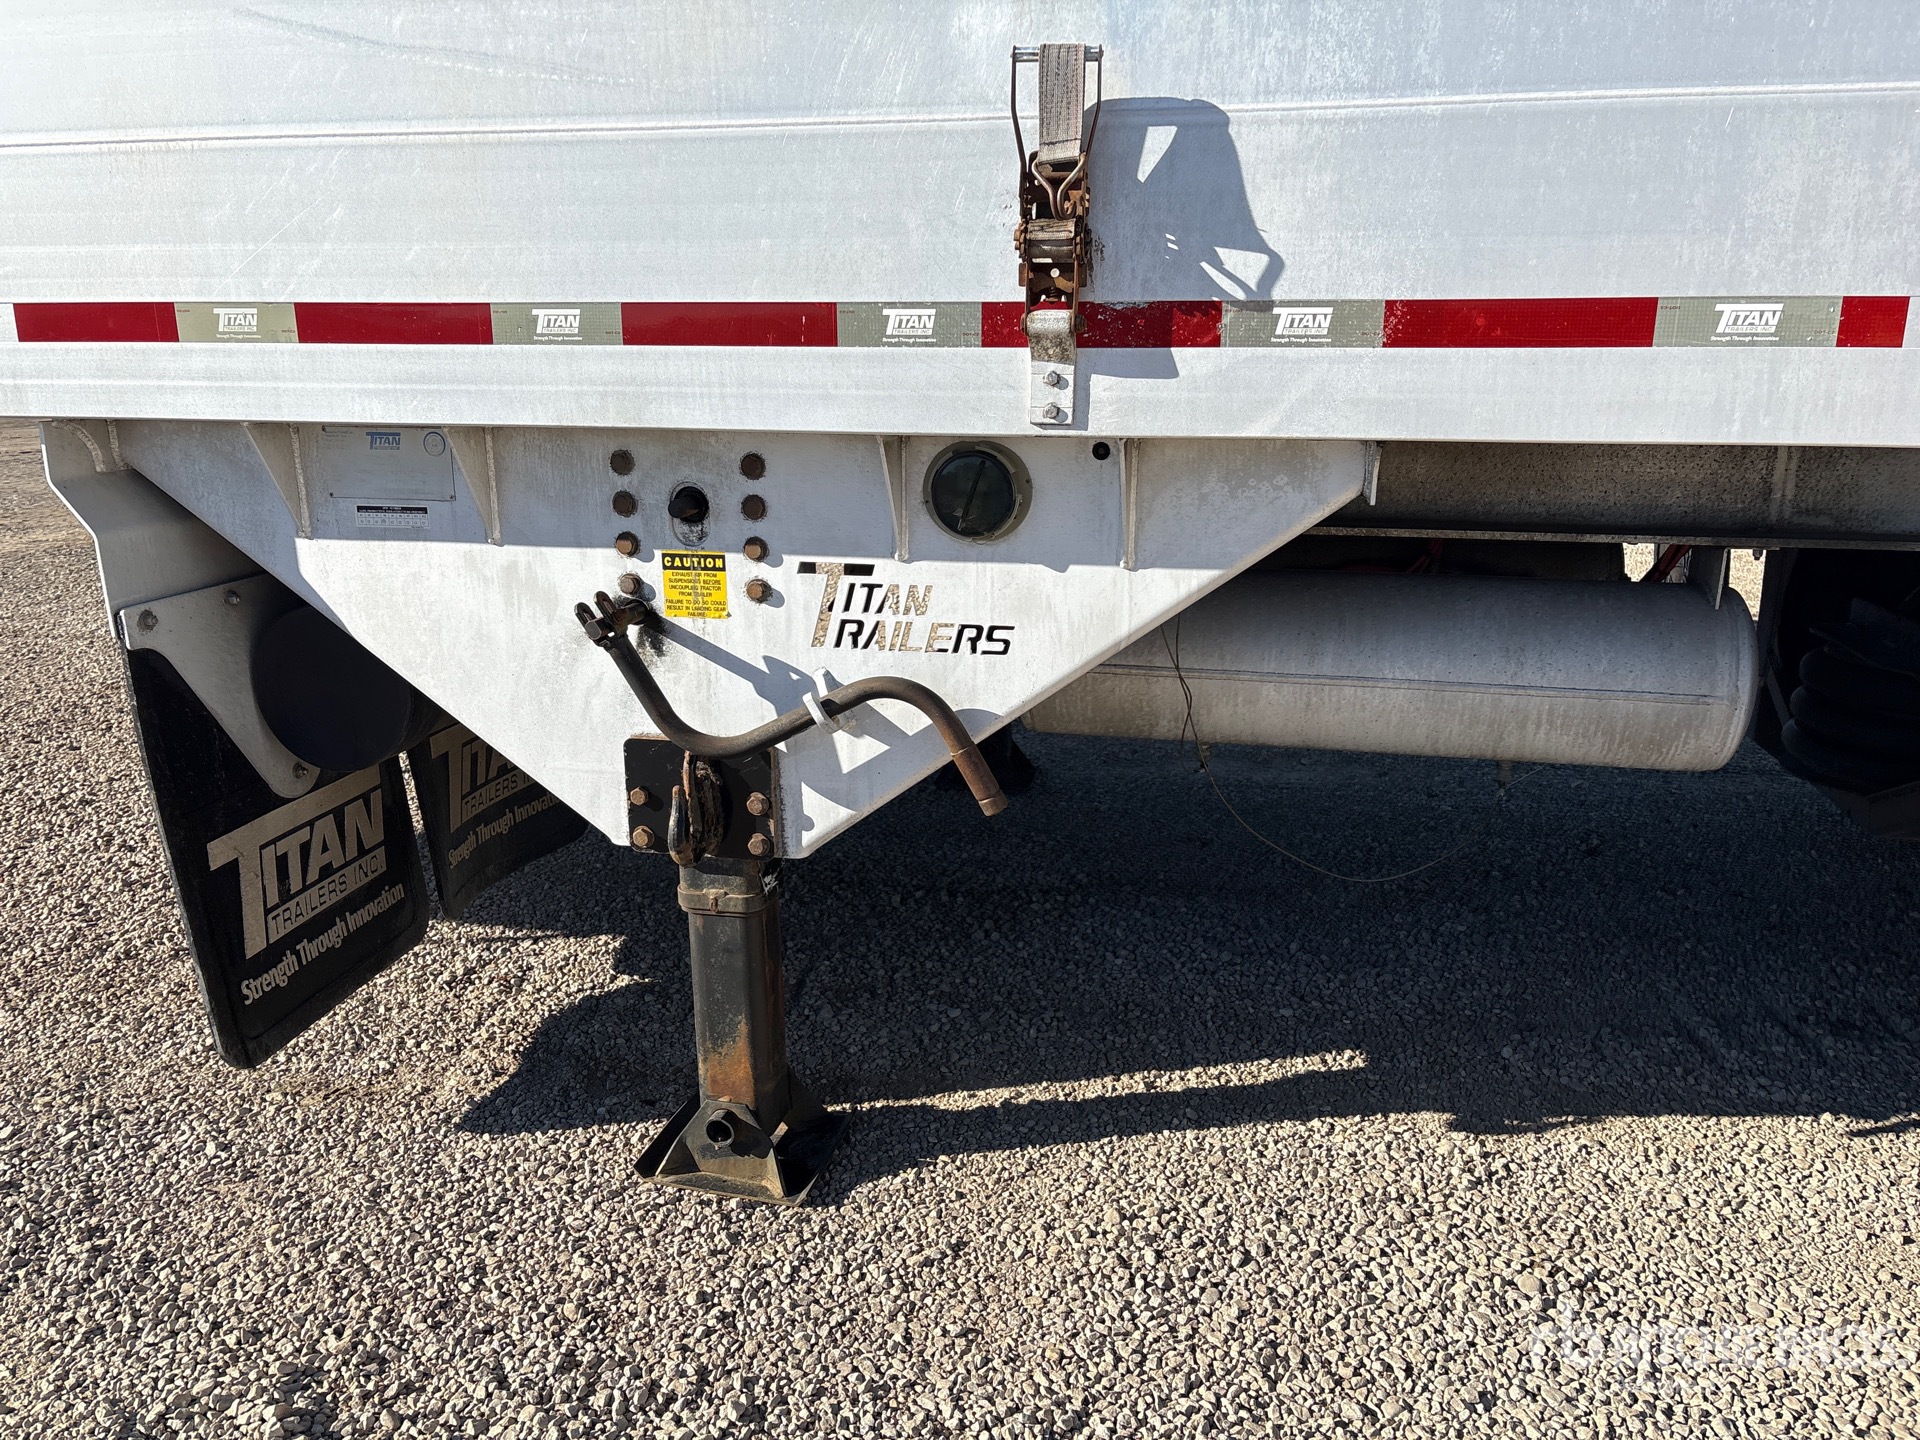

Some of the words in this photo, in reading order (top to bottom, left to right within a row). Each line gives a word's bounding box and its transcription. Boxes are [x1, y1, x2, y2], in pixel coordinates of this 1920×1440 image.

[213, 308, 257, 332] TITAN
[531, 308, 581, 334] TITAN
[882, 308, 936, 335] TITAN
[1272, 306, 1334, 335] TITAN
[1715, 303, 1784, 333] TITAN
[365, 431, 401, 450] TITAN
[663, 556, 723, 568] CAUTION
[796, 560, 934, 648] TITAN
[429, 722, 520, 834] TITA
[463, 773, 519, 821] TRAILERS
[475, 808, 515, 845] Through
[206, 763, 385, 960] TITAN
[270, 877, 348, 936] TRAILERS
[240, 949, 300, 1006] Strength
[296, 917, 348, 966] Through
[345, 882, 405, 932] Innovation
